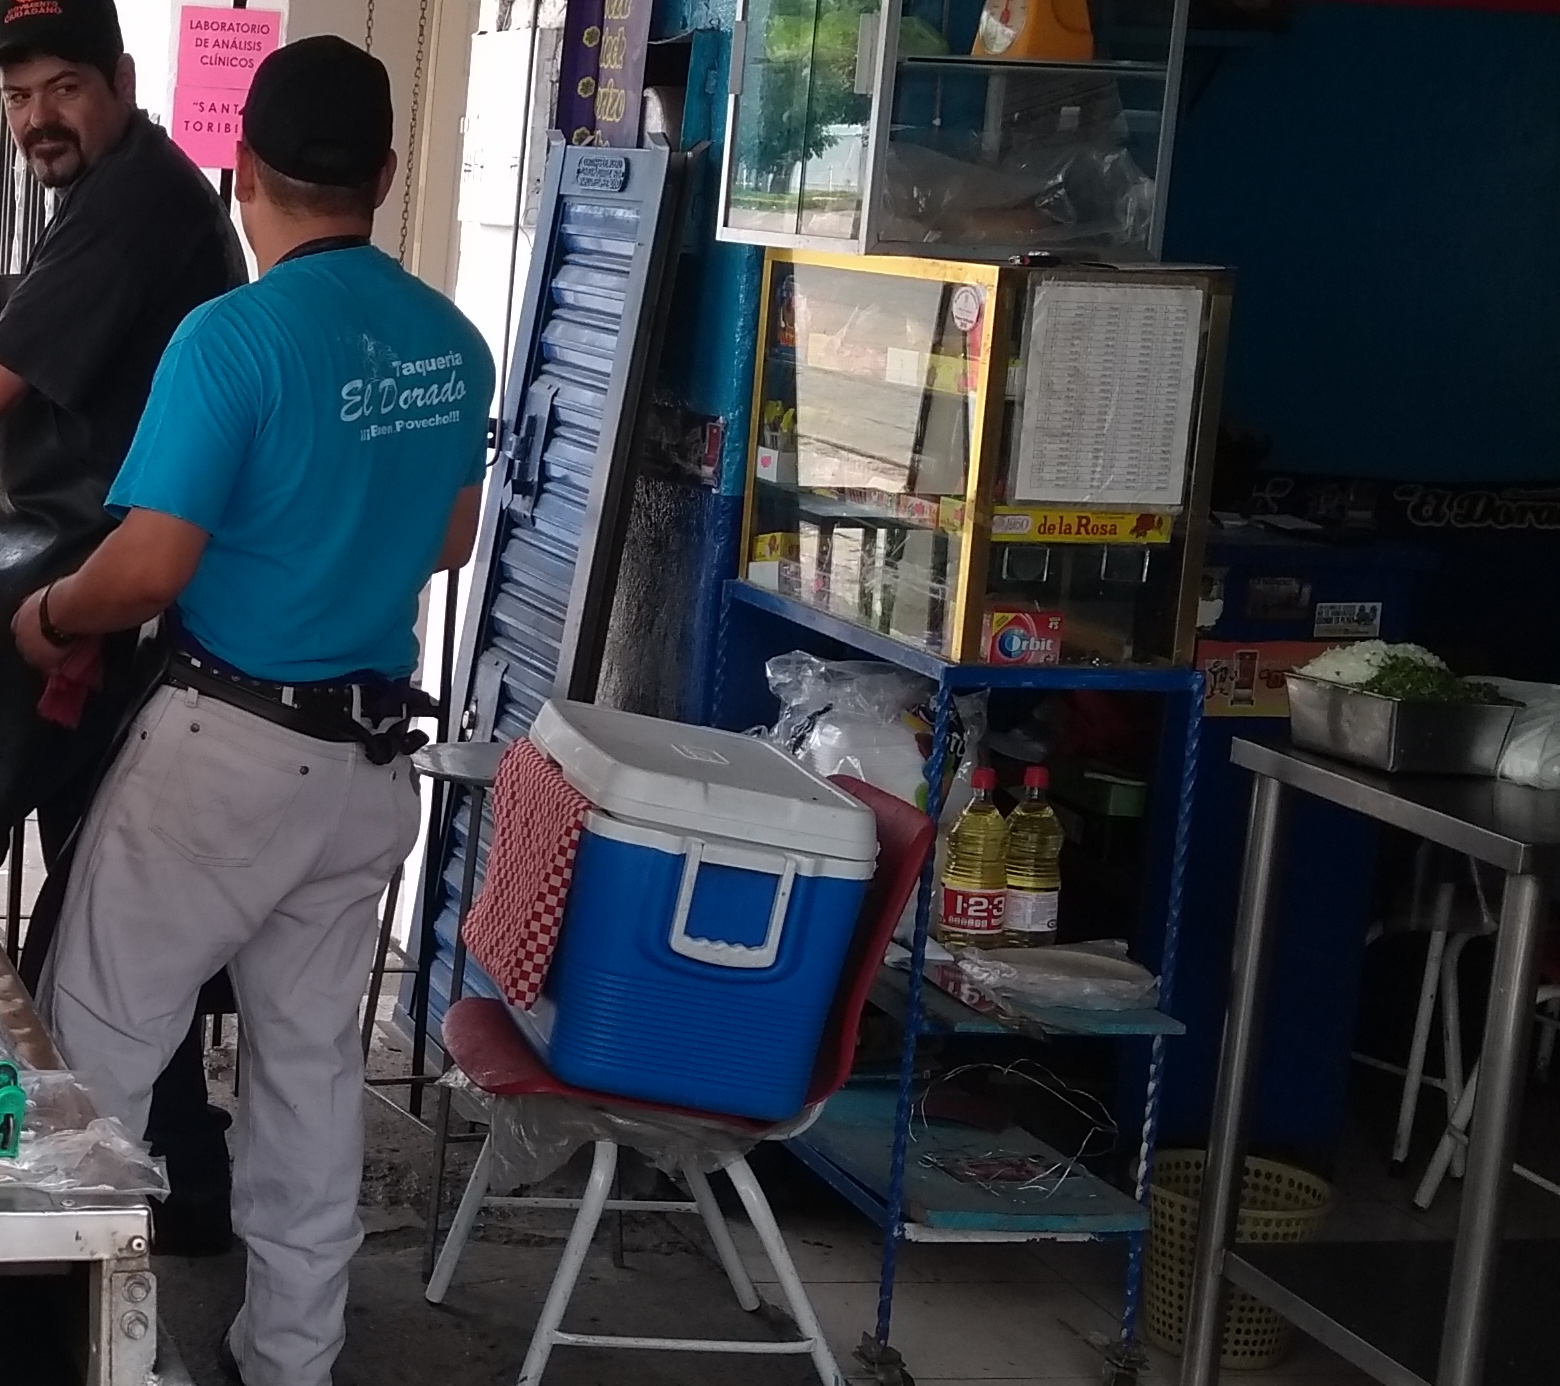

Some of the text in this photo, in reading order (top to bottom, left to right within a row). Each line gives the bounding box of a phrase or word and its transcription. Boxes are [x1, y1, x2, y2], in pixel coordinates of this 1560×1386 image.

[189, 19, 270, 35] LABORATORIO
[194, 37, 262, 52] DE ANÁLISIS
[200, 53, 255, 68] CLÍNICOS
[192, 101, 241, 115] "SANT
[183, 120, 239, 134] TORIBI
[340, 370, 467, 422] El Dorado
[1037, 515, 1119, 536] de la Rosa
[1004, 635, 1054, 651] Orbit
